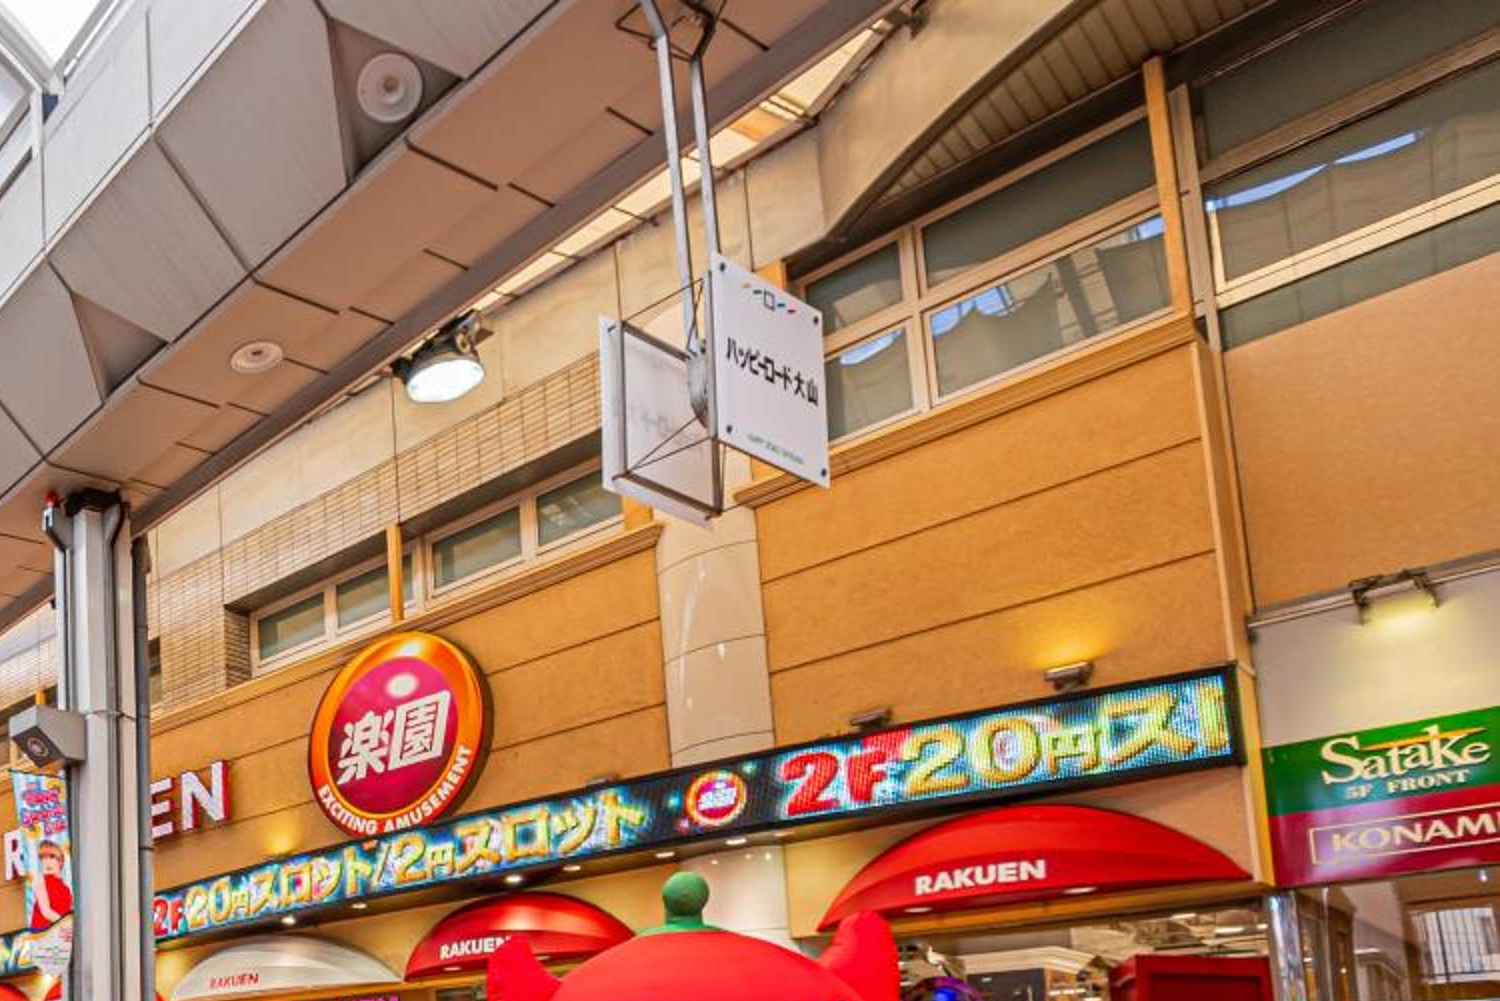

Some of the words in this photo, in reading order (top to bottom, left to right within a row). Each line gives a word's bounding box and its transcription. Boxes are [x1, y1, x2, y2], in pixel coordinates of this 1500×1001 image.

[726, 335, 819, 407] ハッピーロード大山
[337, 689, 451, 785] 楽園
[1321, 724, 1491, 785] Satake
[318, 783, 378, 835] EXCITING
[383, 744, 472, 833] AMUSEMENT
[1387, 769, 1470, 793] FRONT
[914, 860, 1046, 896] RAKUEN
[209, 973, 259, 989] RAKUEN
